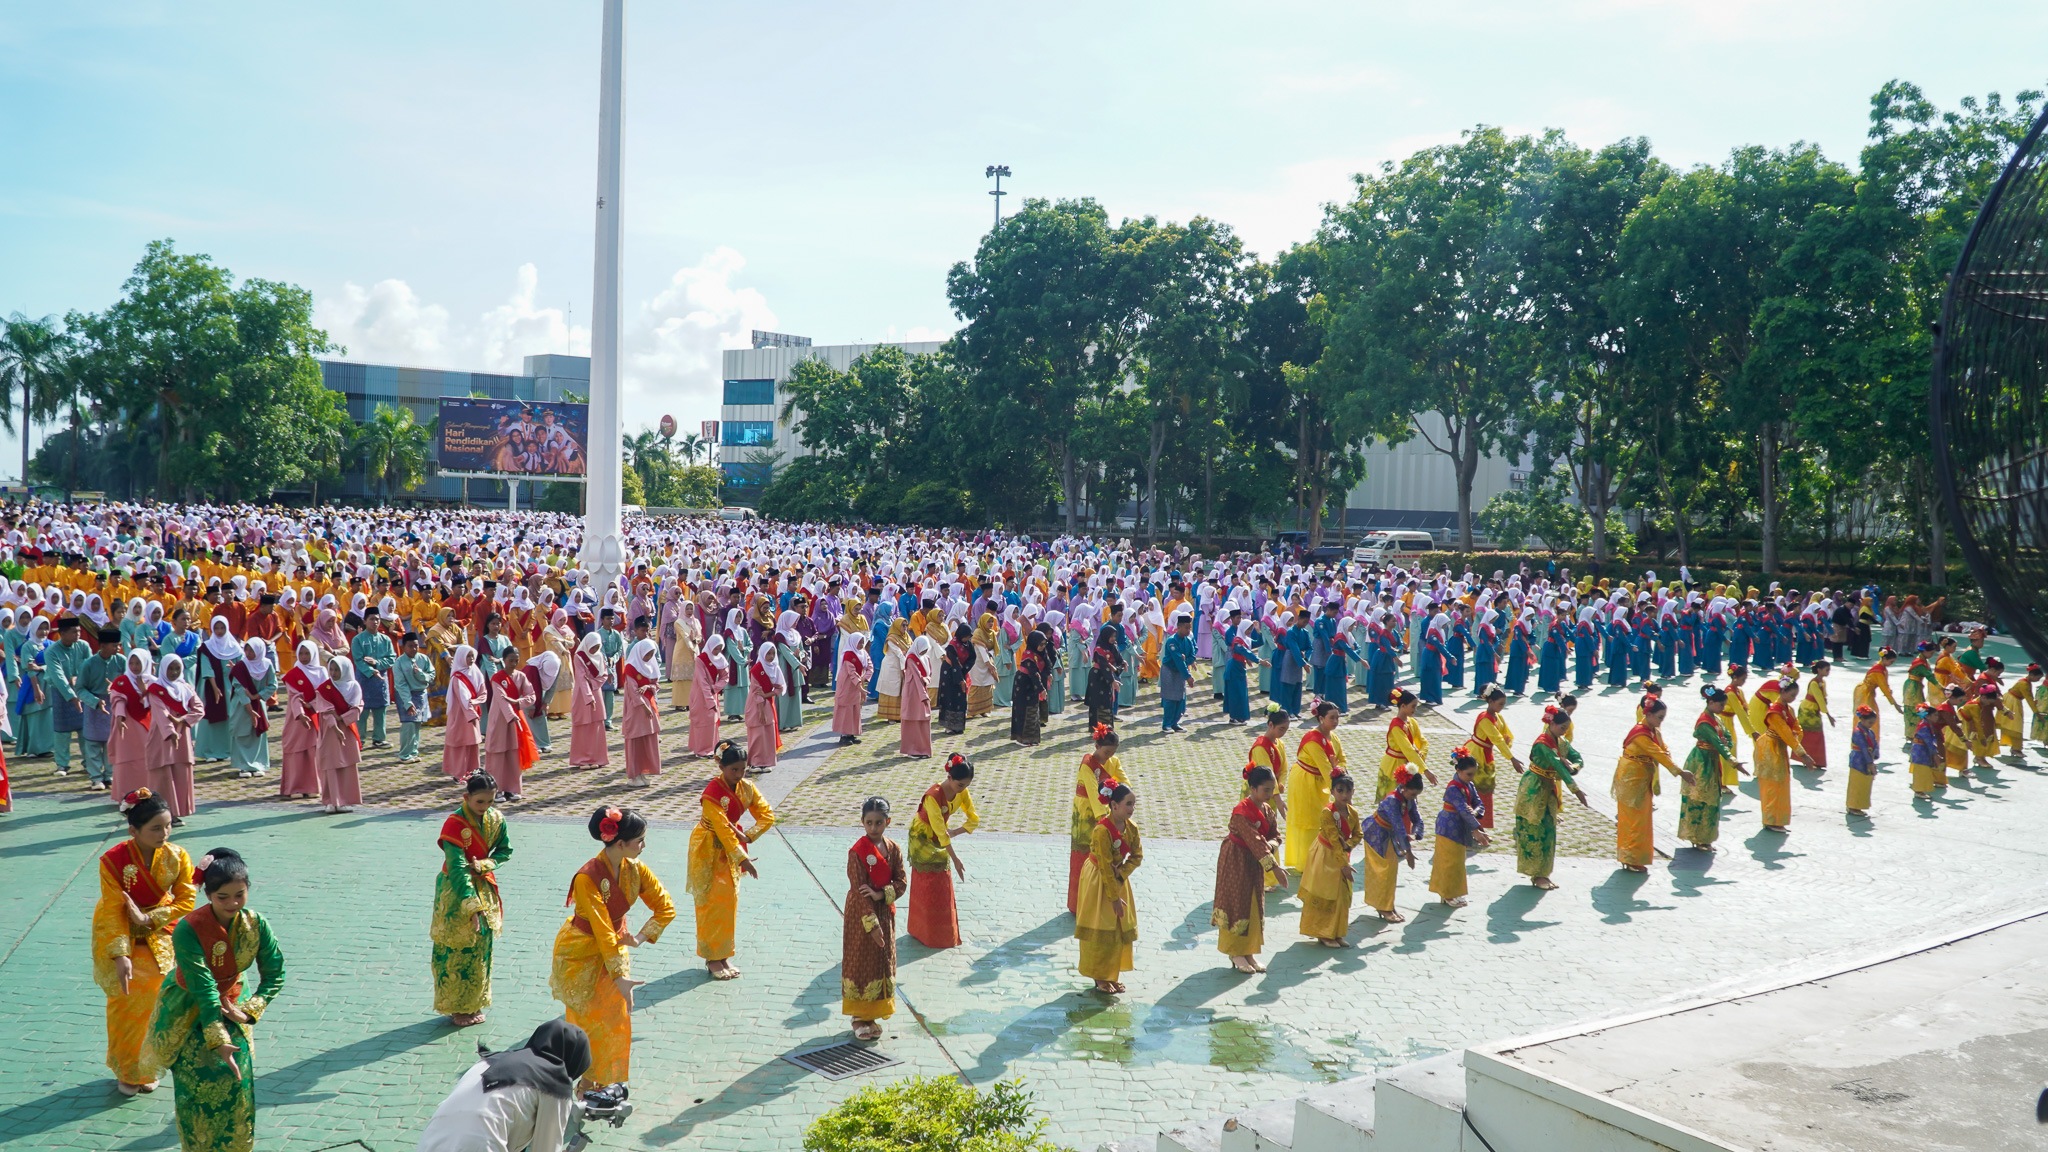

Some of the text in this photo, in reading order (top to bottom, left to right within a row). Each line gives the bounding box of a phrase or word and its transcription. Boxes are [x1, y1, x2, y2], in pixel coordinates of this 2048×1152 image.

[445, 429, 465, 437] Hari
[445, 437, 494, 446] Pendidikan
[445, 445, 484, 453] Nasional
